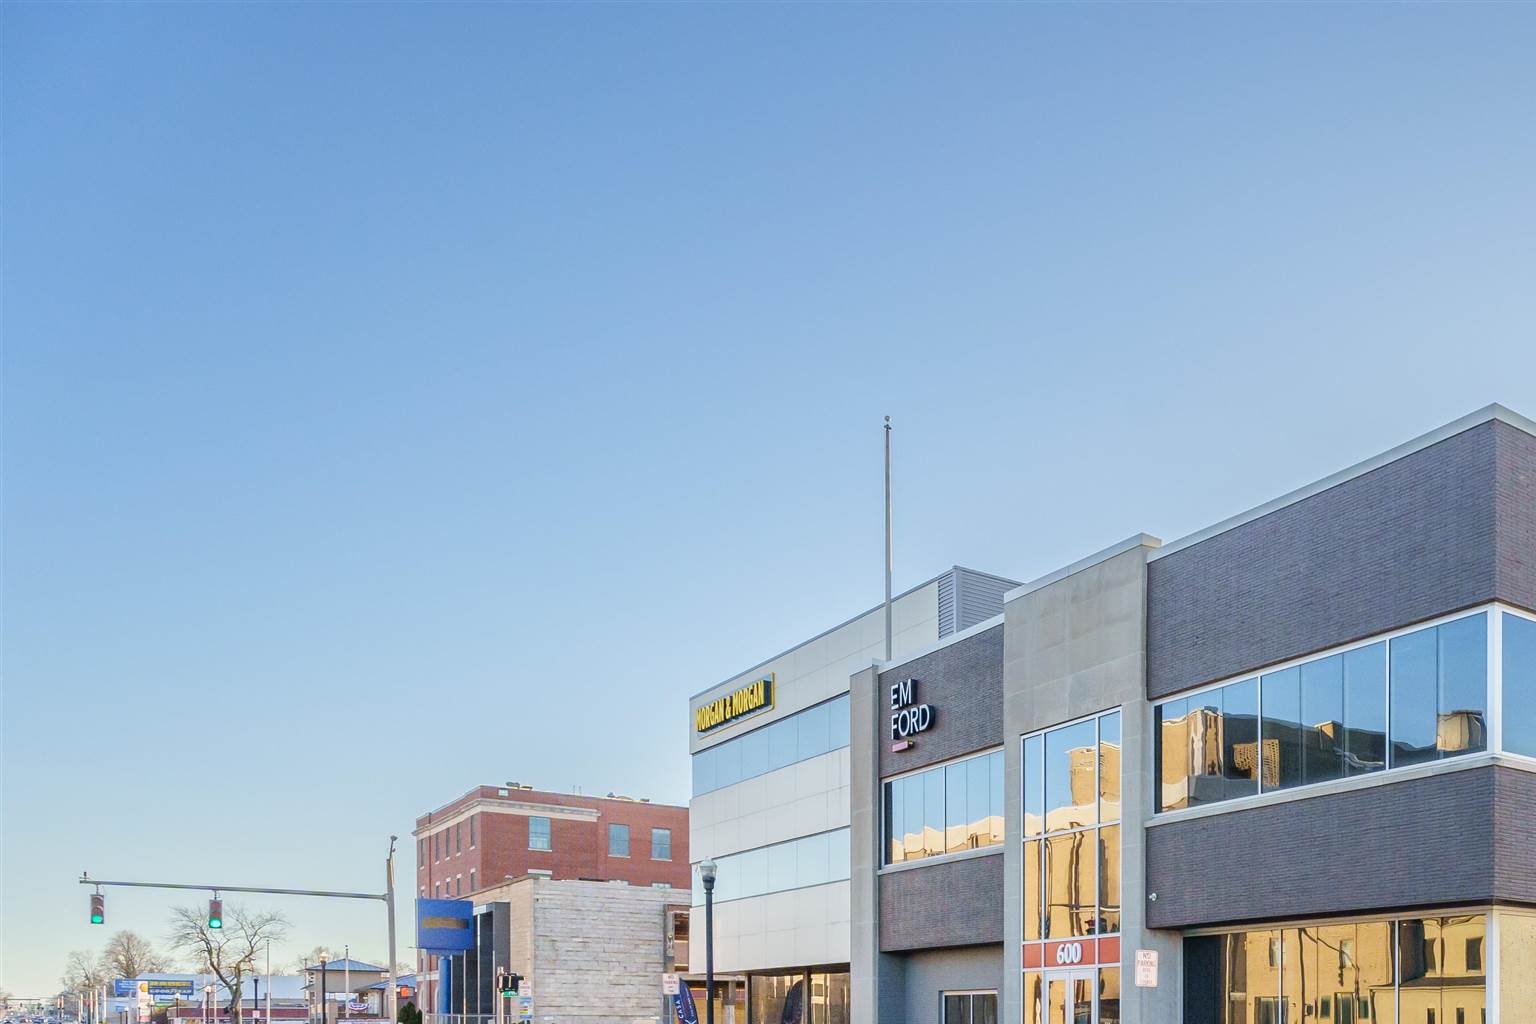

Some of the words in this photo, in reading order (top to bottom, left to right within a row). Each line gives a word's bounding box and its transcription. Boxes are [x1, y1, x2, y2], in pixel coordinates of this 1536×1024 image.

[696, 698, 725, 731] MORGAN
[725, 696, 731, 720] &
[732, 679, 765, 717] MORGAN
[891, 679, 912, 710] EM
[891, 704, 931, 740] FORD
[1056, 942, 1082, 965] 600
